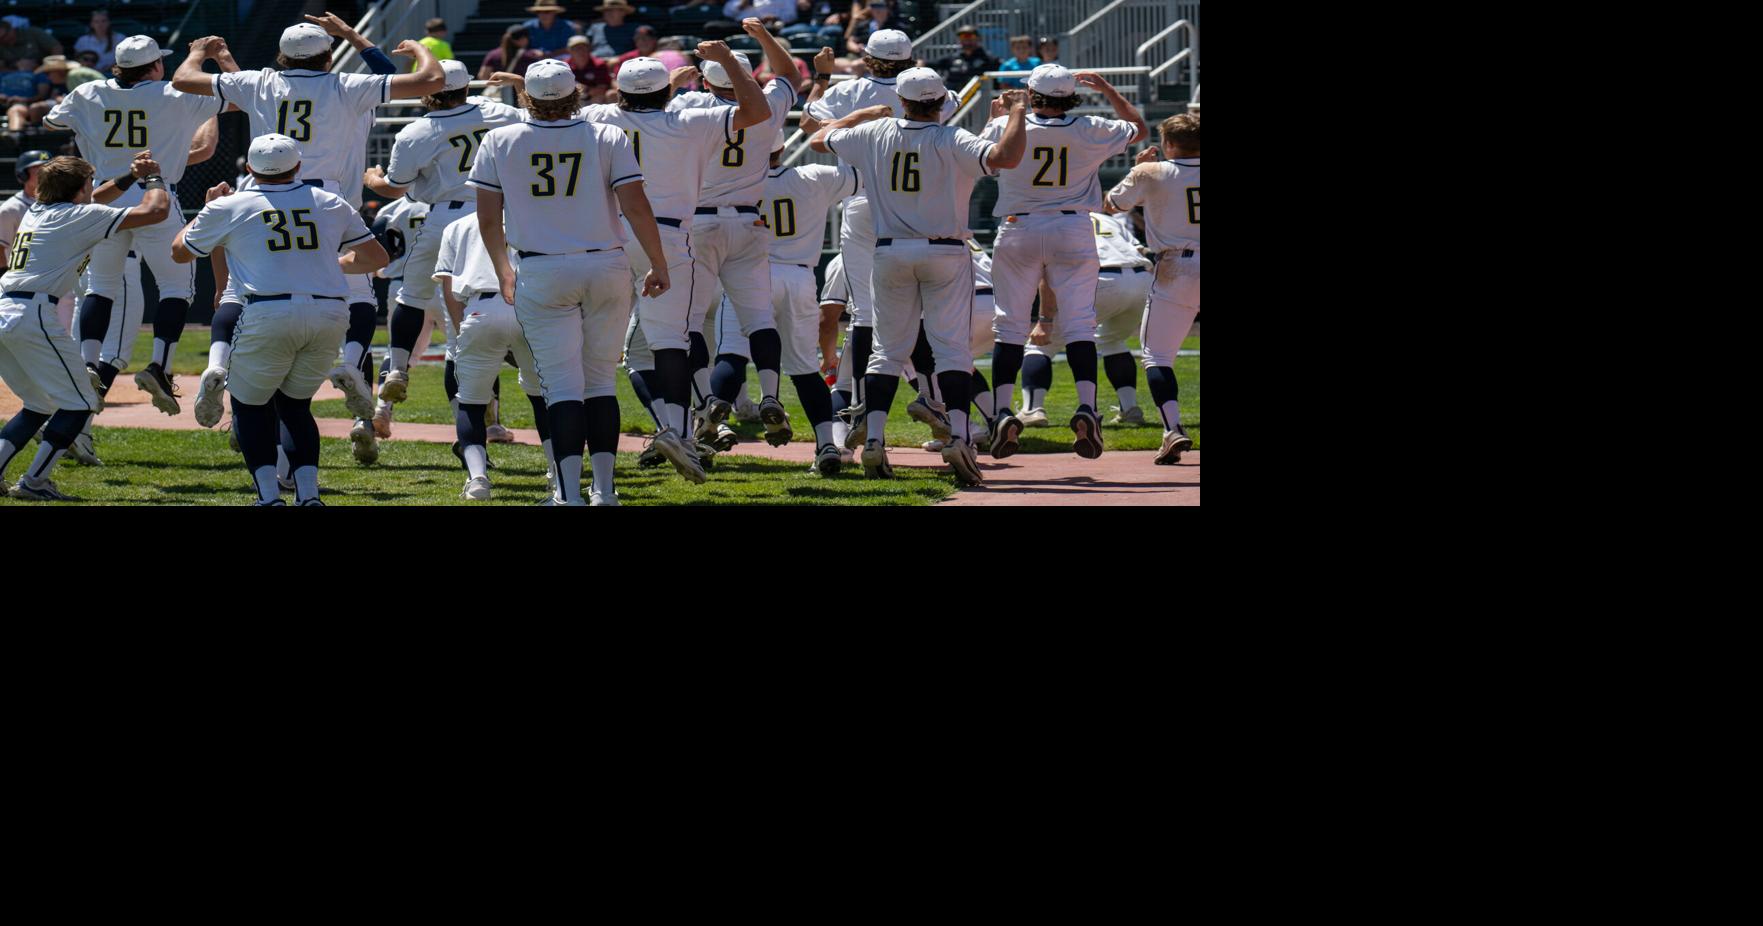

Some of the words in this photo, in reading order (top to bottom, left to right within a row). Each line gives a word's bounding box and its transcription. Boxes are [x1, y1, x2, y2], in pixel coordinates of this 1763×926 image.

[103, 109, 148, 148] 26
[276, 100, 312, 142] 13
[530, 152, 582, 197] 37
[891, 151, 921, 192] 16
[1032, 146, 1068, 187] 21
[262, 208, 319, 252] 35
